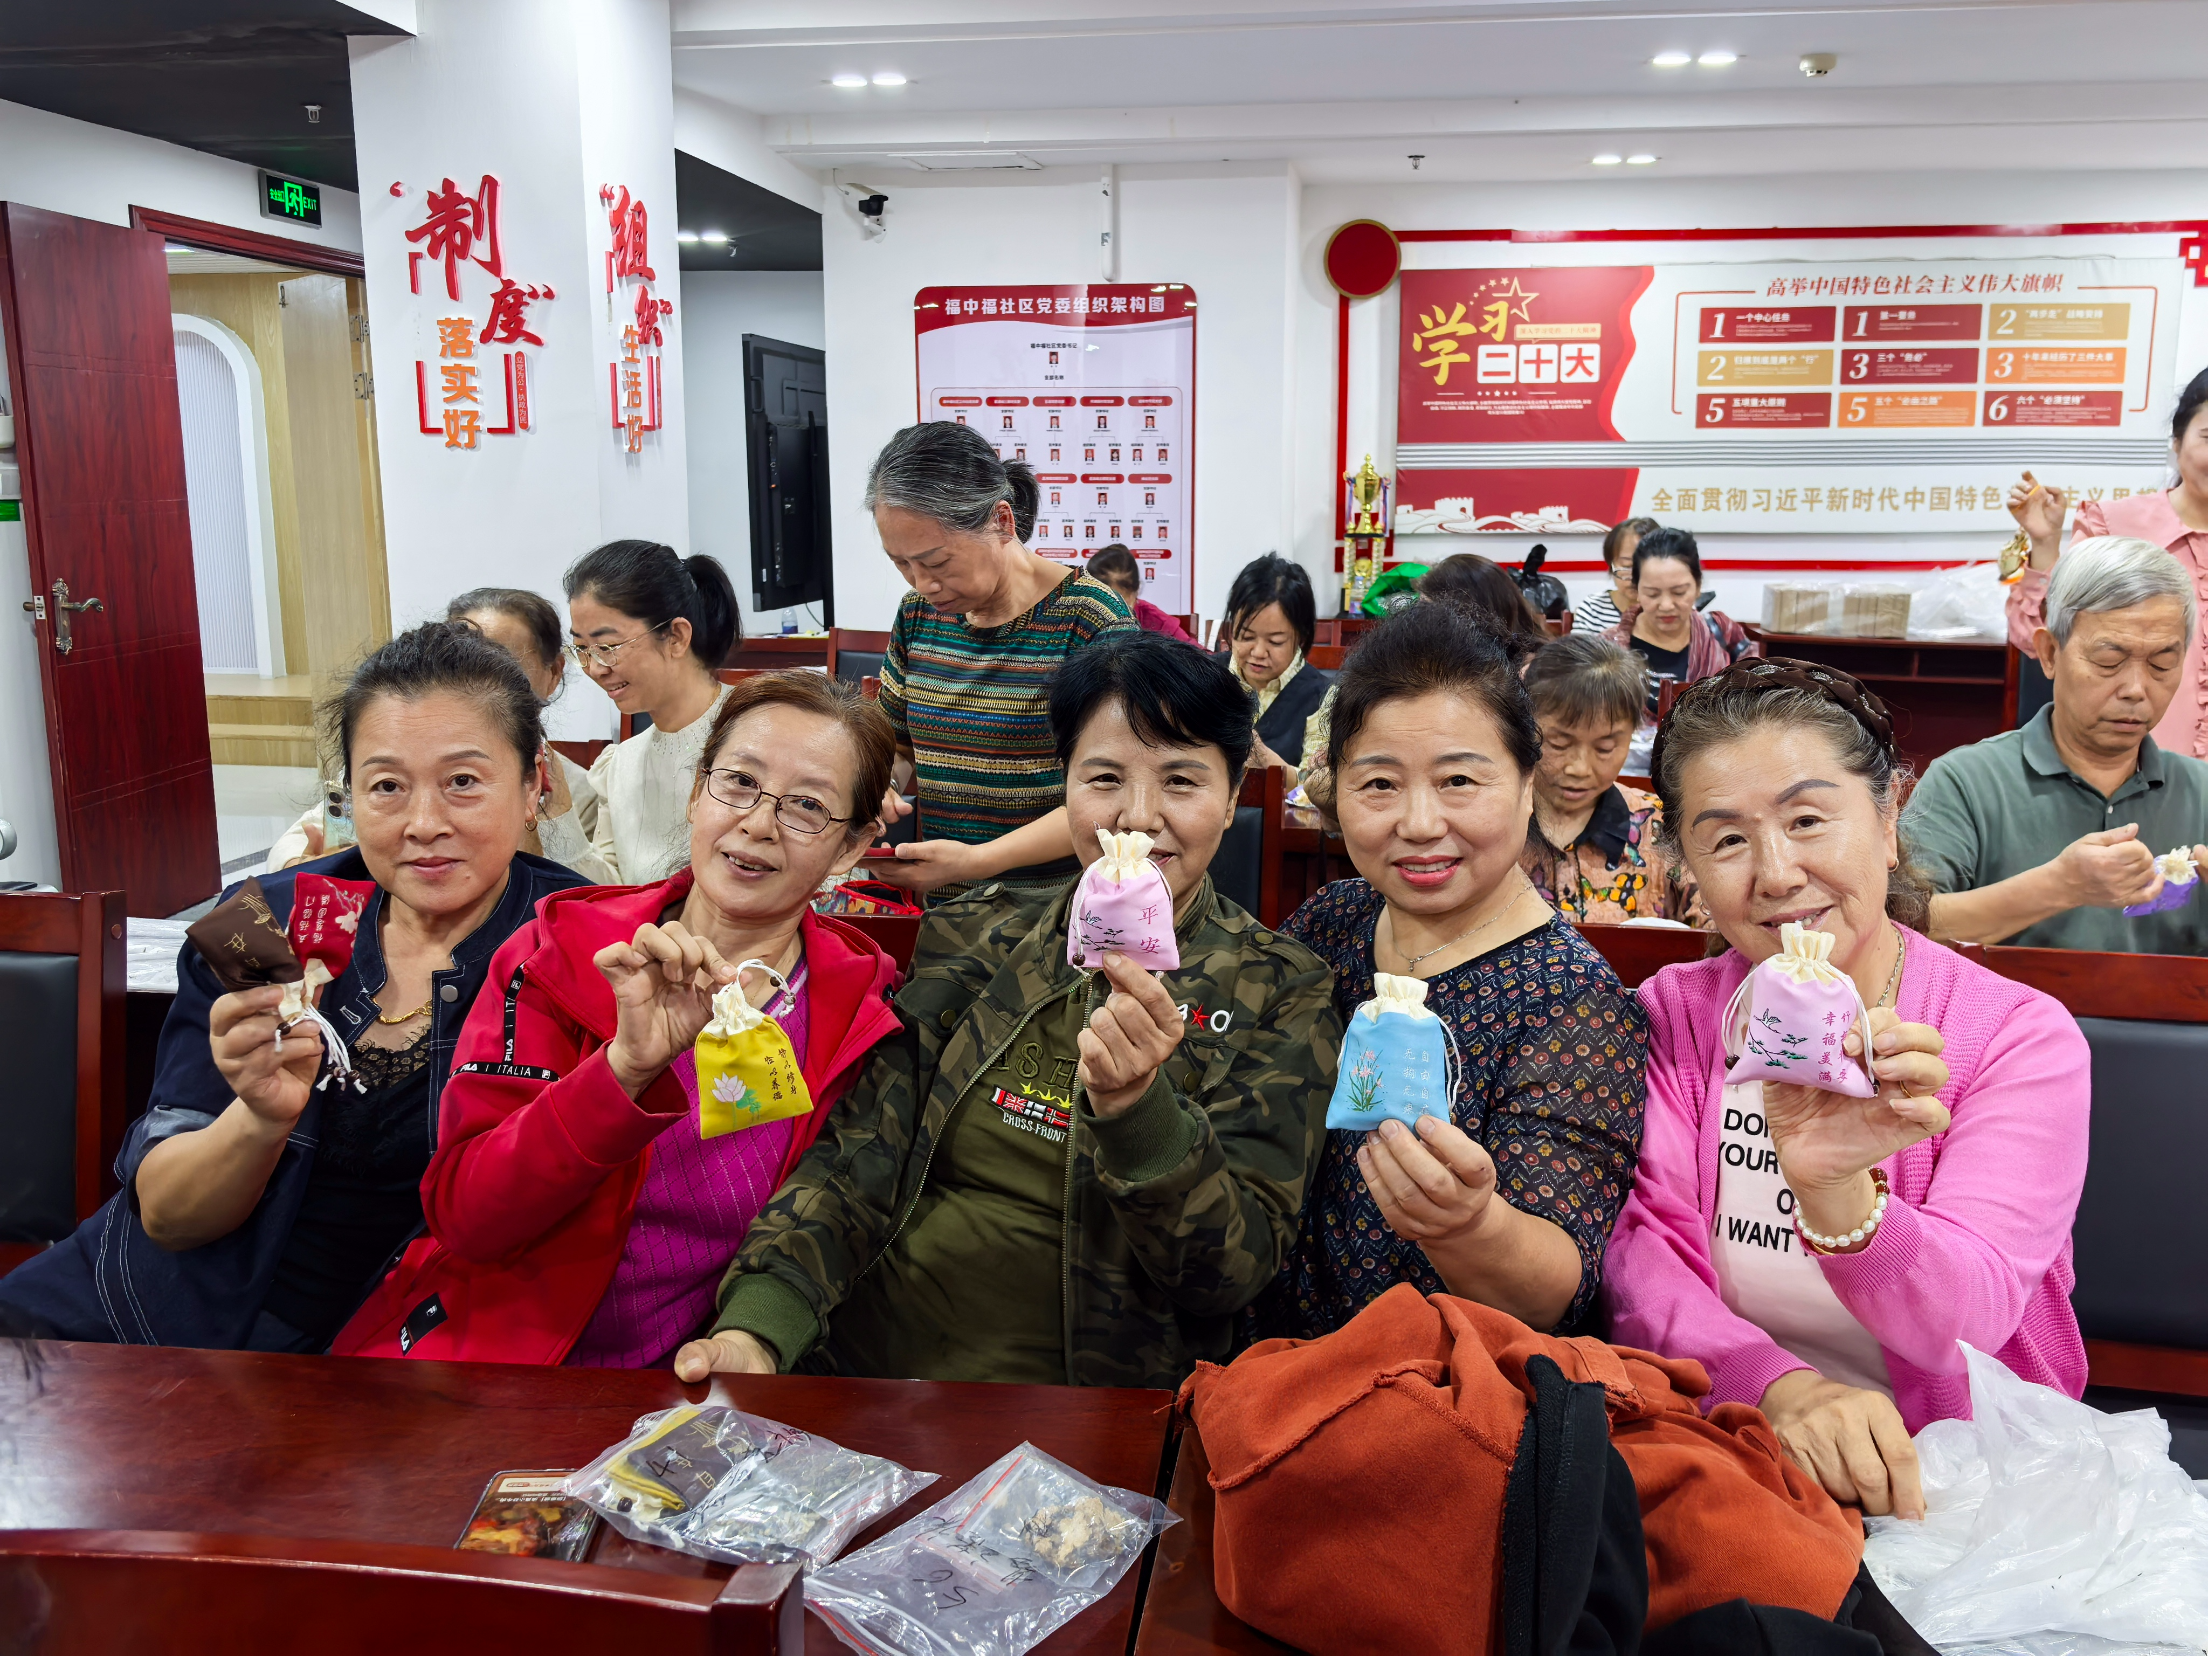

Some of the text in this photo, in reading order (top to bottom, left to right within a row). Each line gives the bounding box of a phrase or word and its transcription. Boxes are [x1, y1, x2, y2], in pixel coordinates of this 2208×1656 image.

[303, 197, 317, 211] EXIT
[1766, 273, 2064, 298] 高举中国特色社会主义伟大旗帜
[945, 297, 1165, 316] 福中福社区党委组织架构图
[1708, 313, 1727, 338] 1
[1851, 311, 1870, 337] 1
[1995, 309, 2017, 335] 2
[1412, 300, 1509, 386] 学习
[1482, 347, 1595, 379] 二十大
[1706, 355, 1727, 380] 2
[1848, 353, 1870, 379] 3
[1993, 352, 2015, 378] 3
[436, 317, 483, 449] 落实好
[620, 324, 645, 454] 生活好
[1705, 398, 1726, 423] 5
[1847, 397, 1869, 422] 5
[1988, 395, 2010, 421] 6
[1651, 486, 2158, 512] 全面贯彻习近平新时代中国特色主义
[1138, 904, 1161, 955] 平安
[505, 1038, 514, 1062] FILA
[1818, 1011, 1837, 1083] 幸福美满
[497, 1064, 531, 1077] ITALIA
[1728, 1216, 1795, 1253] WANT
